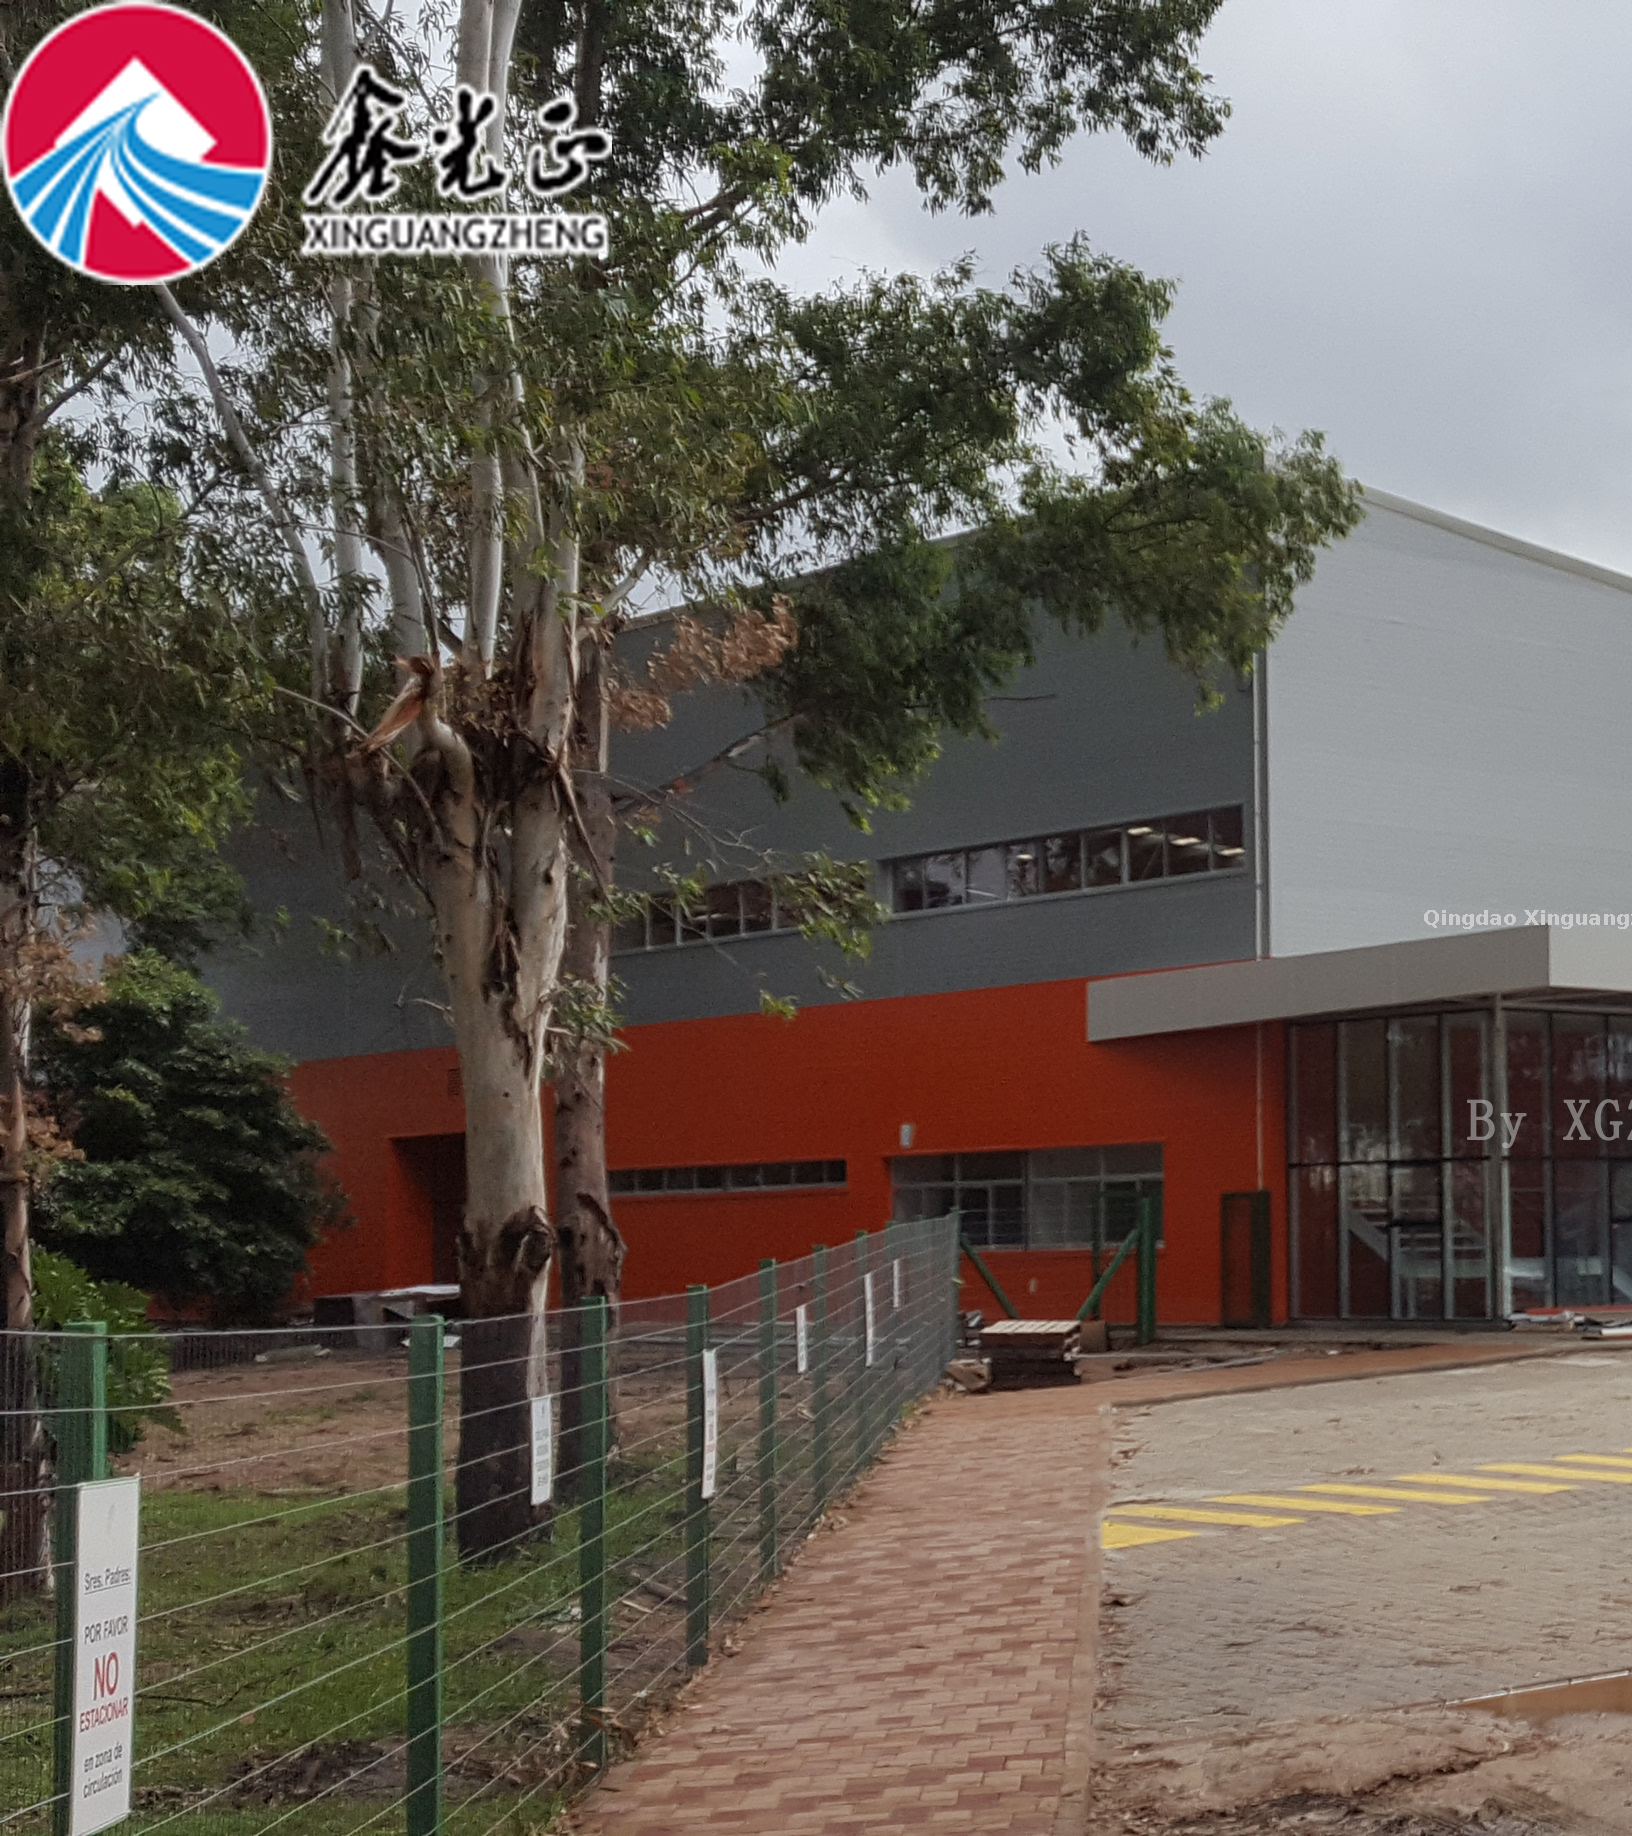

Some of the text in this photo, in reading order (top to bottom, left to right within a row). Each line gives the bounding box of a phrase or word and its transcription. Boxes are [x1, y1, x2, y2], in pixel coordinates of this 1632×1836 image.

[84, 1614, 129, 1645] POR FAVOR
[93, 1651, 119, 1701] NO
[79, 1696, 129, 1733] ESTACIONAR
